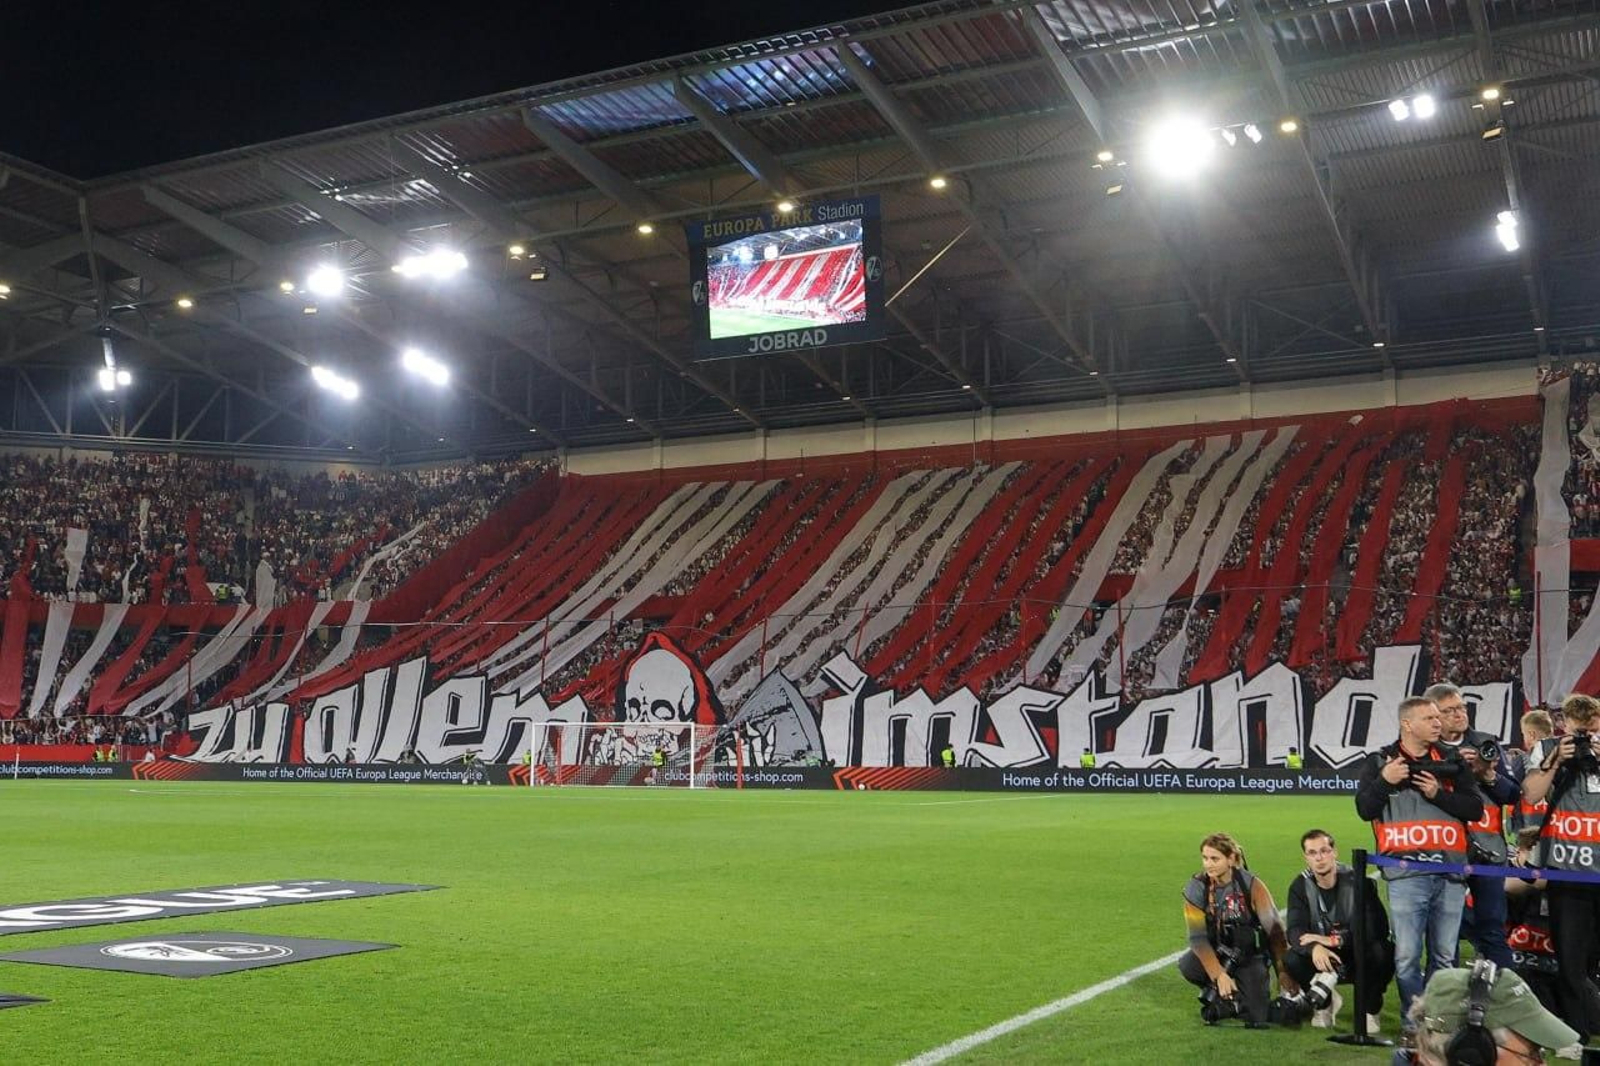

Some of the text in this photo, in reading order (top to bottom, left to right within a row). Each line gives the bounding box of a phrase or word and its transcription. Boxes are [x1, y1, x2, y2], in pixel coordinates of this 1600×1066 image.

[703, 202, 864, 239] EUROPA PARK Stadion
[748, 328, 828, 352] JOBRAD
[170, 703, 293, 763] zu
[242, 766, 267, 778] Home
[269, 766, 279, 778] of
[280, 767, 294, 778] the
[296, 766, 328, 779] Official
[330, 767, 353, 779] UEFA
[355, 767, 387, 782] Europa
[389, 768, 422, 782] League
[1002, 772, 1041, 787] Home
[1044, 772, 1060, 787] of
[1062, 773, 1085, 787] the
[1089, 773, 1139, 787] Official
[1143, 774, 1182, 788] UEFA
[1186, 774, 1236, 790] Europa
[1240, 775, 1294, 792] League
[1384, 824, 1458, 847] PHOTO
[1553, 843, 1594, 867] 078
